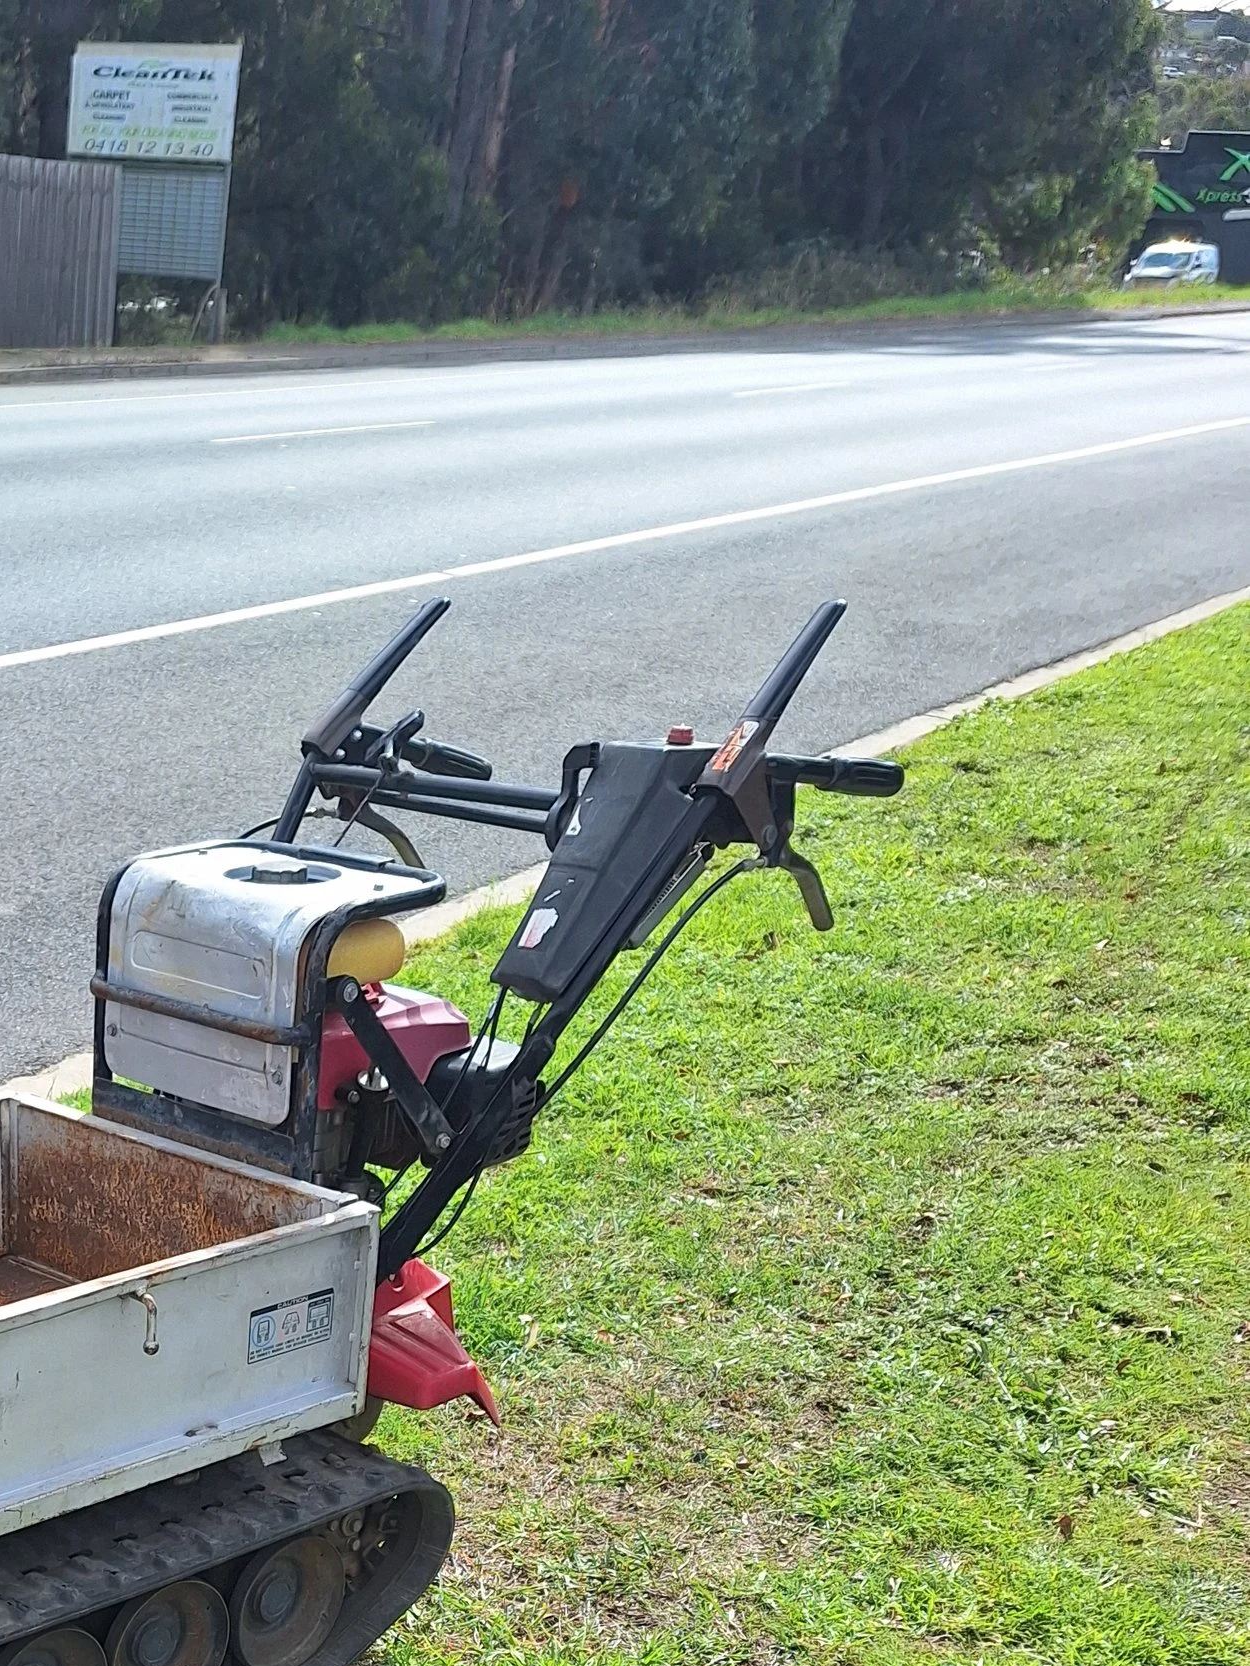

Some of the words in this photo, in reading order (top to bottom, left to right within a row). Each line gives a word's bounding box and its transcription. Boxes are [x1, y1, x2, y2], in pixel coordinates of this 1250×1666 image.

[93, 65, 216, 82] CleanTek
[92, 89, 131, 99] CARPET
[84, 138, 129, 153] 0418
[137, 141, 157, 153] 12
[166, 142, 185, 155] 13
[190, 143, 214, 157] 40
[277, 1296, 309, 1309] CAUTION
